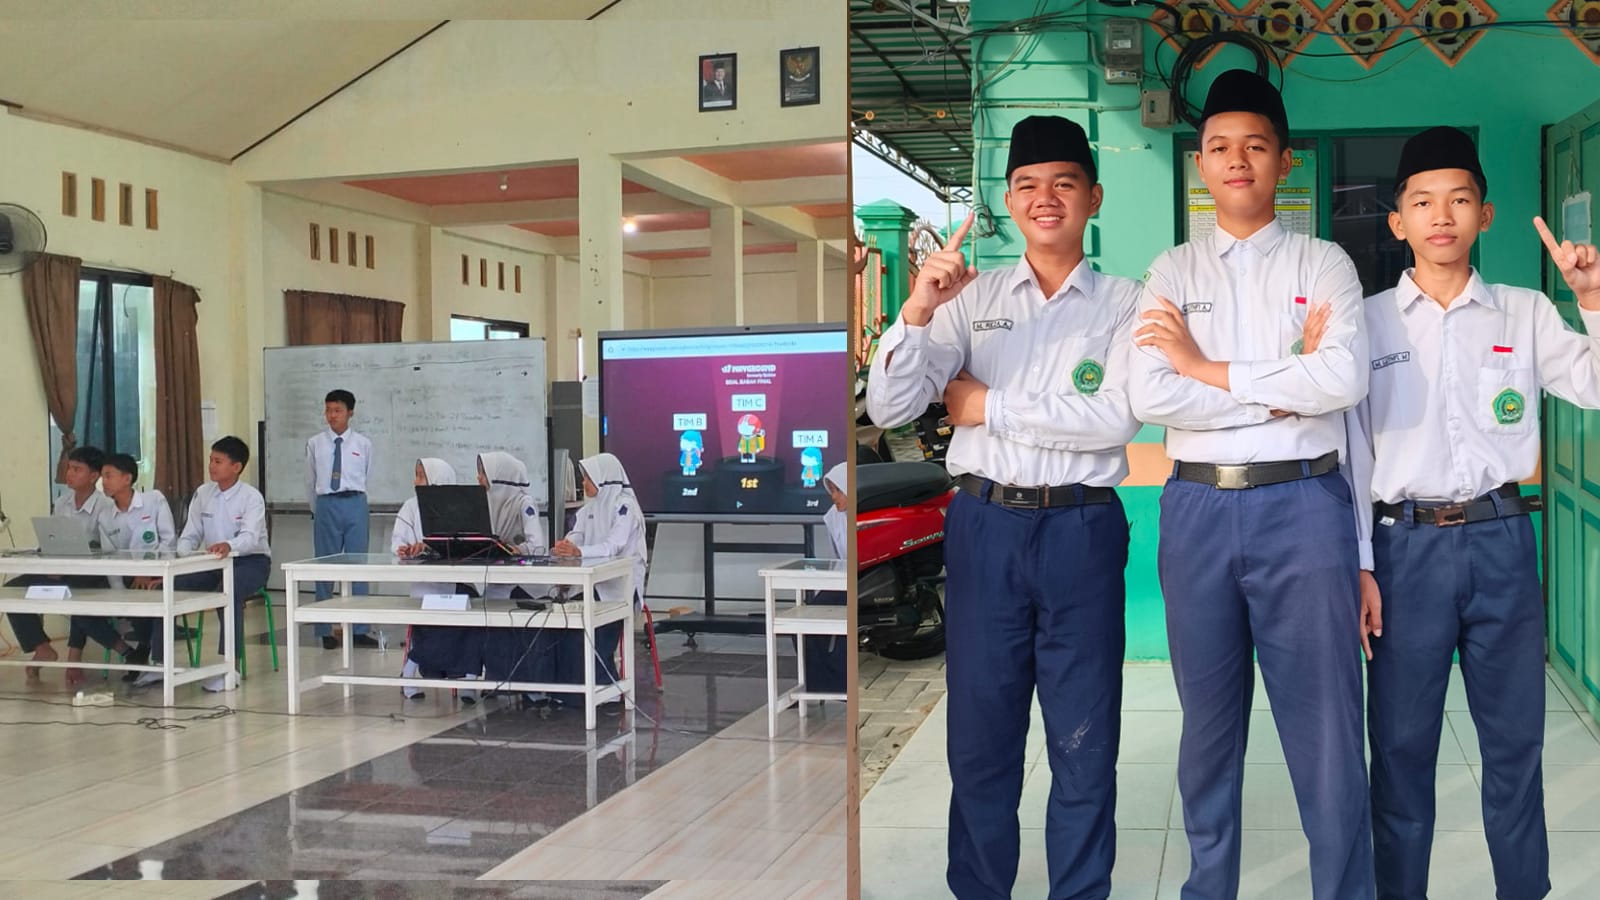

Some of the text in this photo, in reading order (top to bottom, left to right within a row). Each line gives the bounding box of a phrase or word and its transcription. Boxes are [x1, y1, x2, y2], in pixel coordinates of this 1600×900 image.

[737, 398, 763, 407] TIM C
[678, 418, 703, 427] TIM B
[798, 434, 824, 444] TIM A
[741, 478, 759, 489] 1st
[682, 488, 698, 496] 2nd
